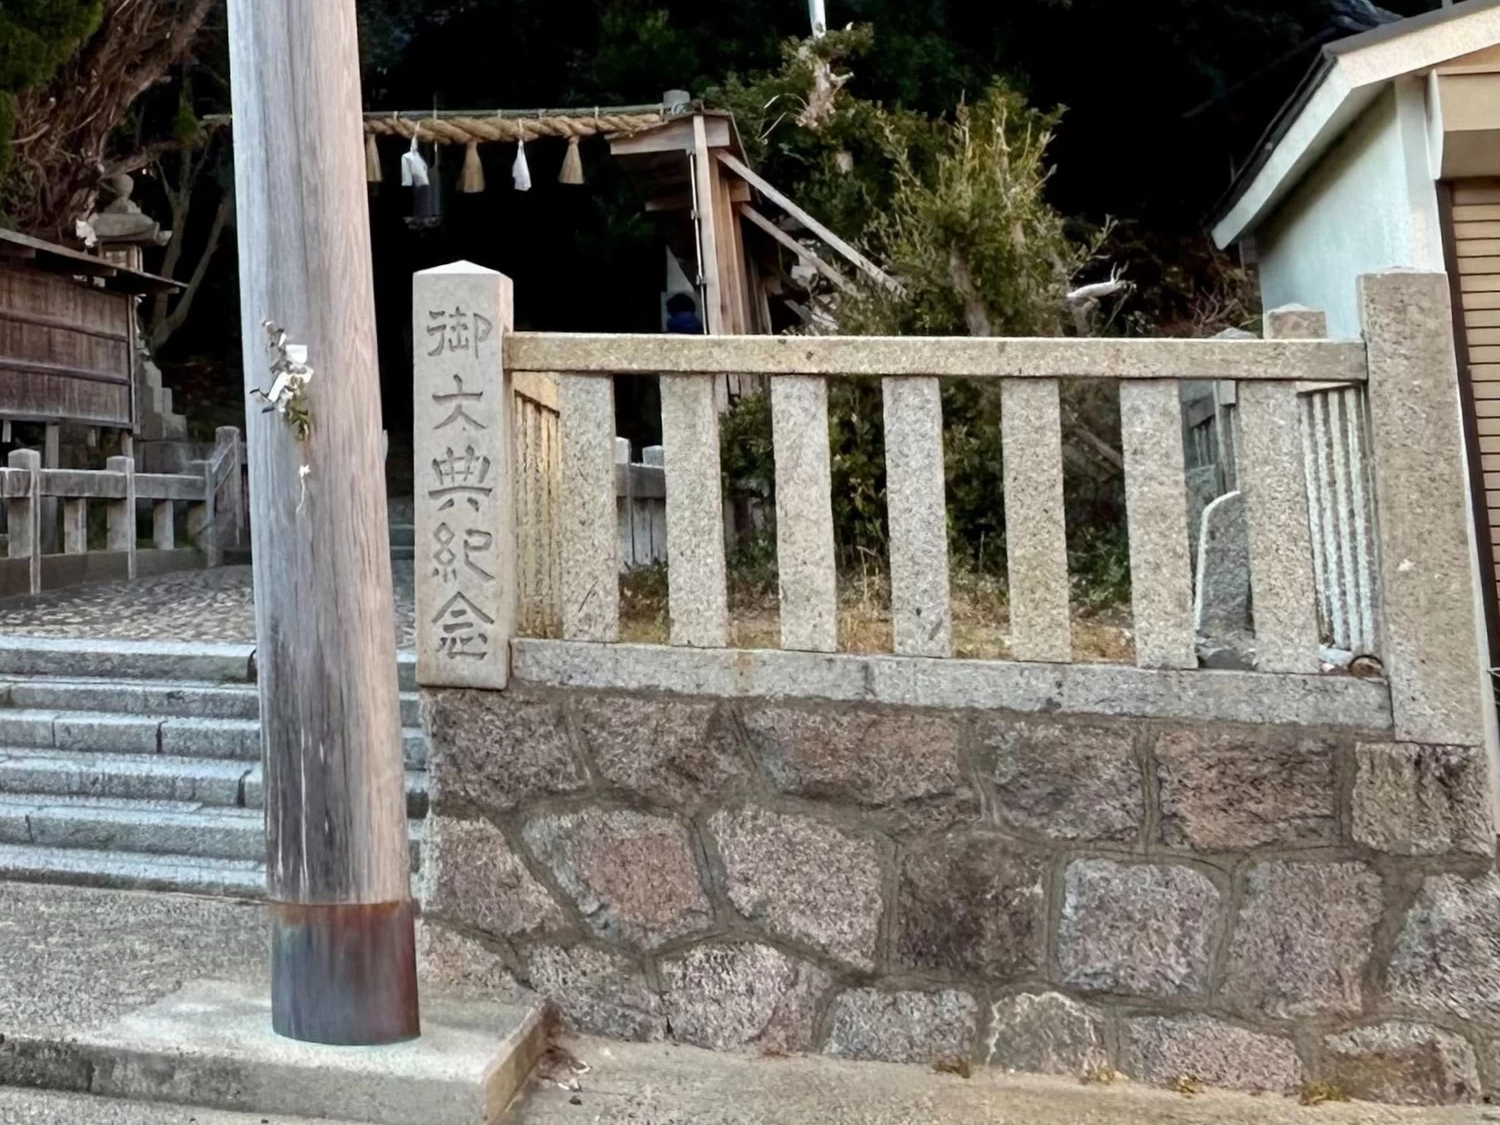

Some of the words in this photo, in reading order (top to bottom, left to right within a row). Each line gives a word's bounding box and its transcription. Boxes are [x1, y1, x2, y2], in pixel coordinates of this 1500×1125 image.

[426, 306, 496, 661] 御大典紀念
